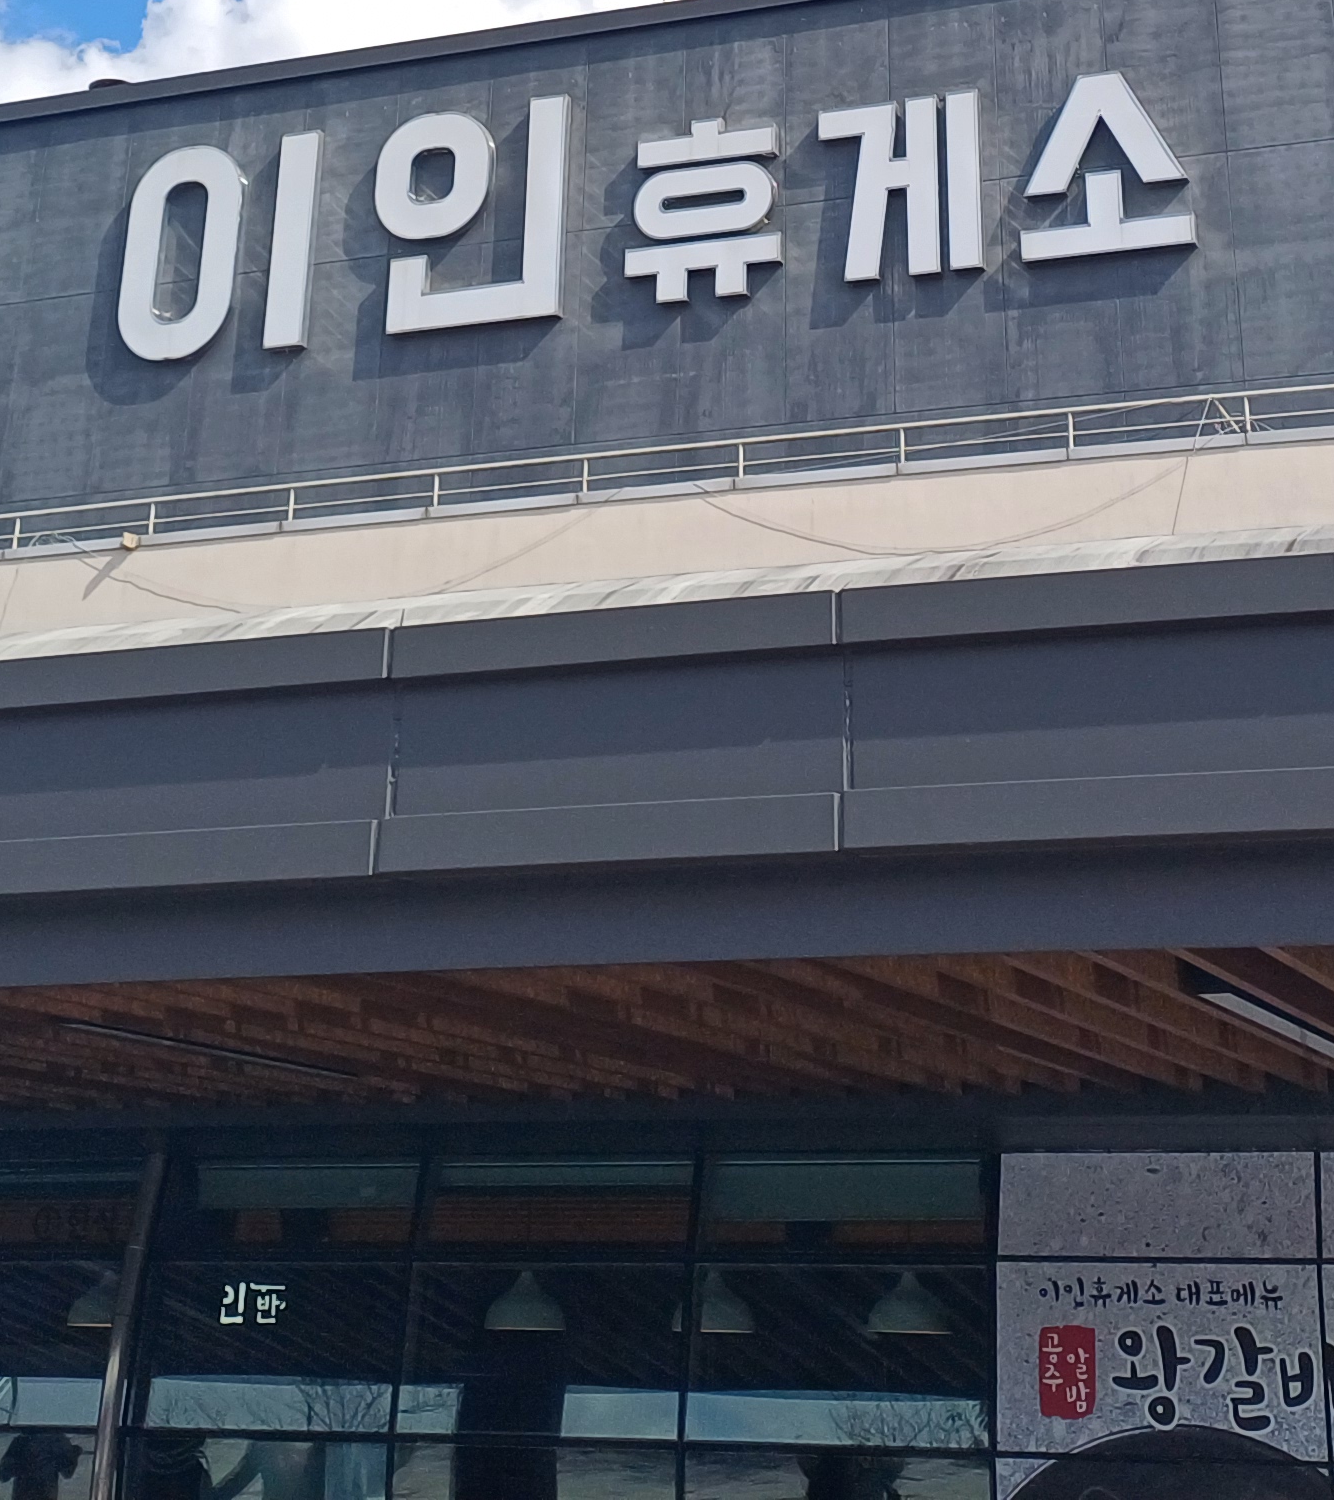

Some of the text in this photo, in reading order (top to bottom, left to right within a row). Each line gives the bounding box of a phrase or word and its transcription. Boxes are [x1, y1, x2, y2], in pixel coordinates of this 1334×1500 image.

[117, 70, 1198, 361] 이인휴게소
[1039, 1276, 1284, 1310] 이인휴게소 대표메뉴
[1042, 1333, 1064, 1393] 공주
[1066, 1347, 1090, 1414] 알밤
